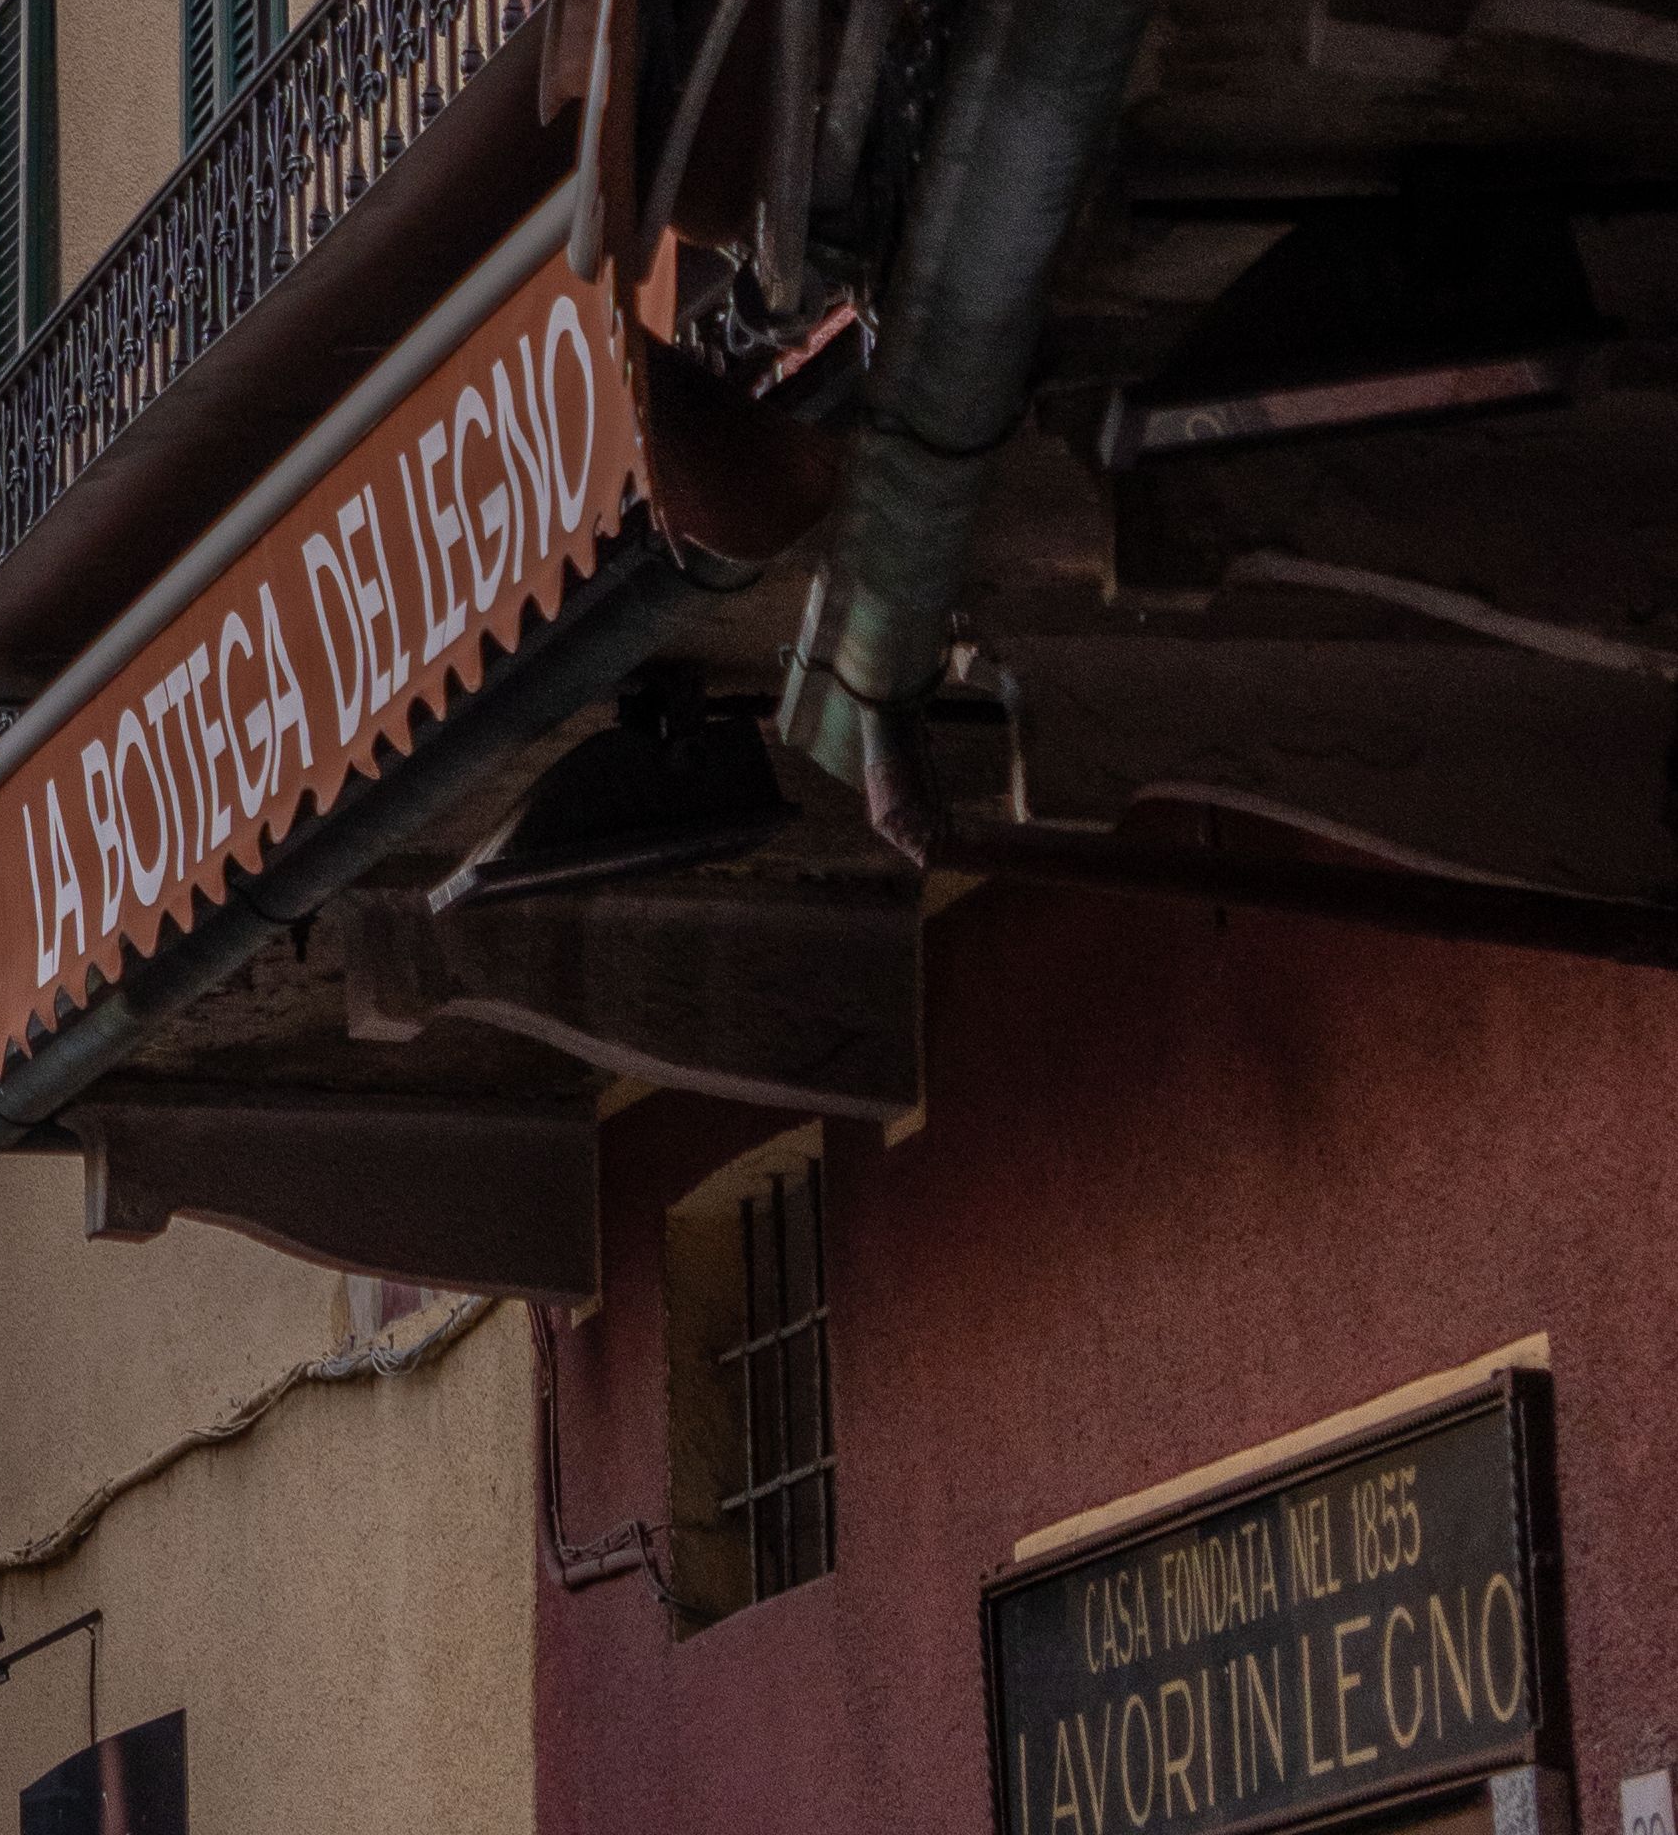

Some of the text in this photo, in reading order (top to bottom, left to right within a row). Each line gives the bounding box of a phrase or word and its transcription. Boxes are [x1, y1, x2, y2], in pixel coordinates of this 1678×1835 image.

[23, 295, 596, 989] LA BOTTEGA DEL LEGNO
[1084, 1464, 1422, 1675] CASA FONDATA NEL 1855
[1229, 1652, 1285, 1799] IN
[1299, 1572, 1523, 1777] LEGNO
